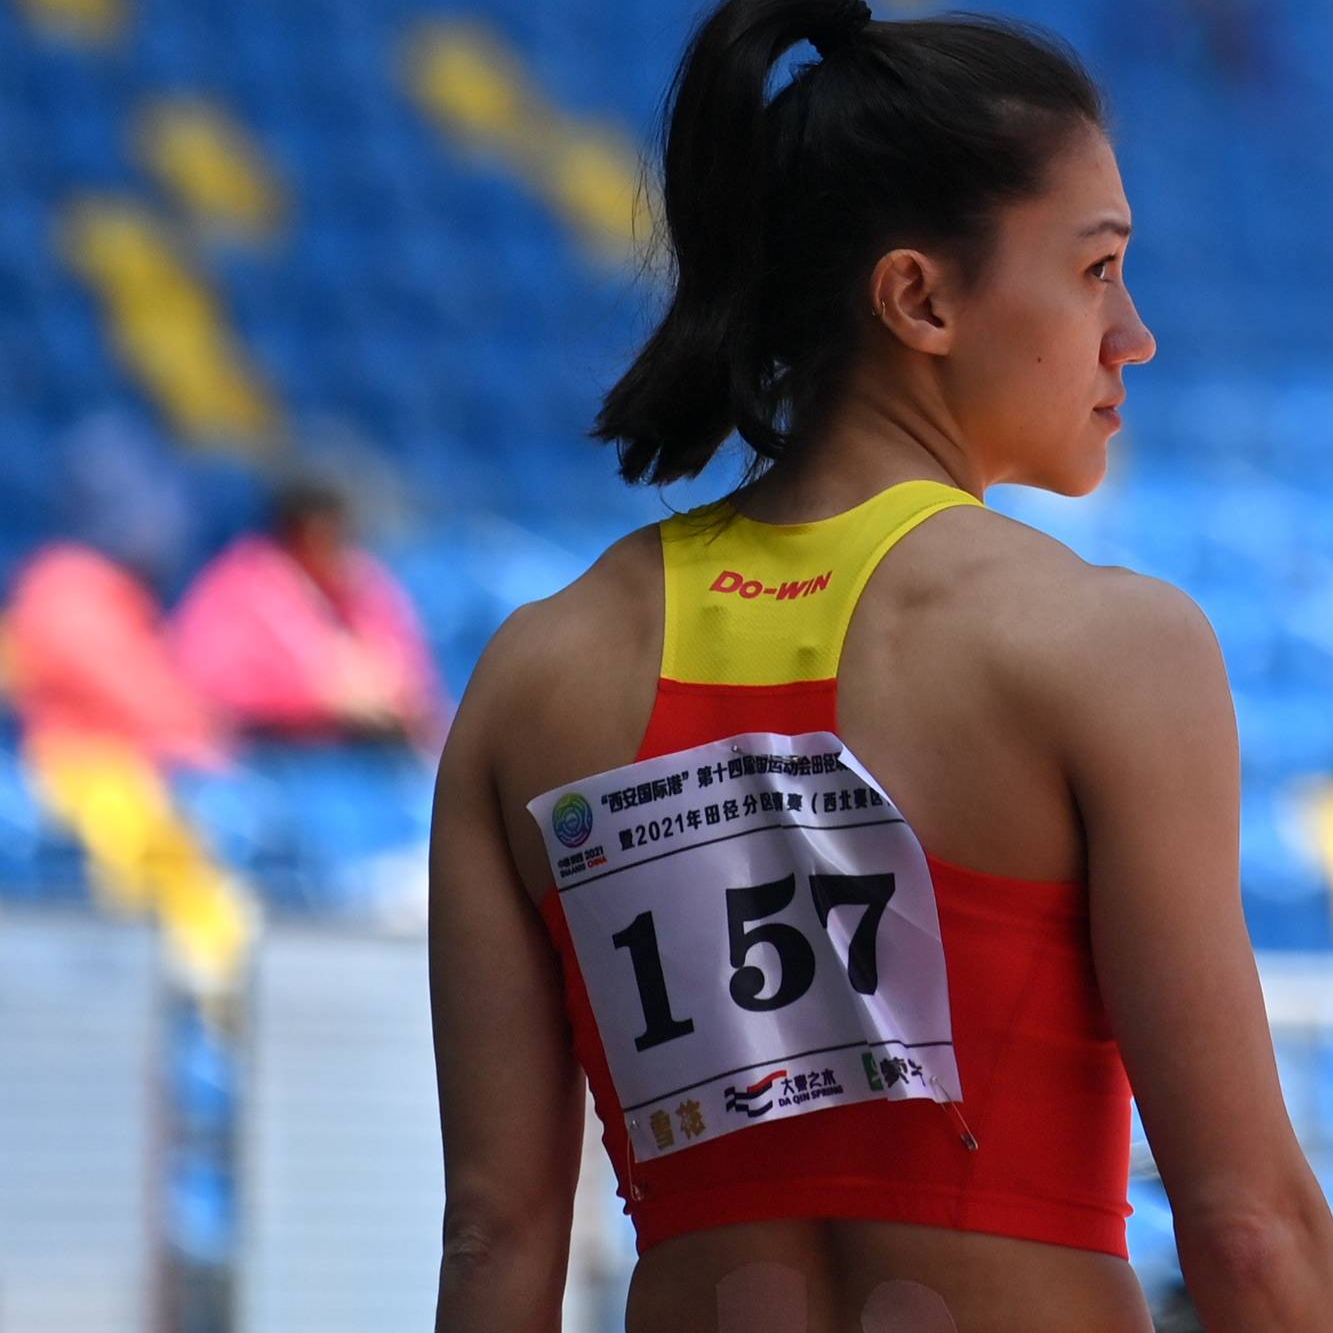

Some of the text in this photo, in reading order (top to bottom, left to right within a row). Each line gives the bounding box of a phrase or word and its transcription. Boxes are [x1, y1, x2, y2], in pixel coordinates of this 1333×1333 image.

[612, 873, 895, 1053] 157
[778, 1085, 844, 1107] DA QIN SPRING
